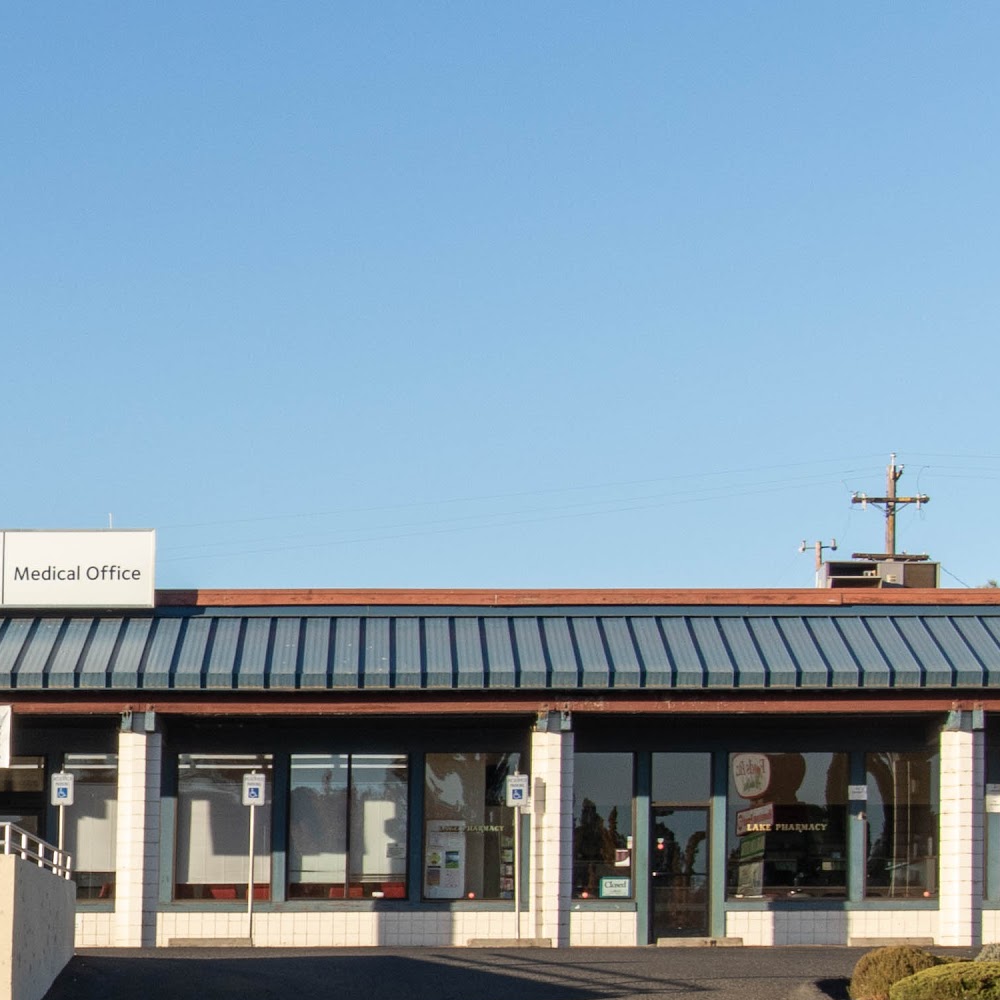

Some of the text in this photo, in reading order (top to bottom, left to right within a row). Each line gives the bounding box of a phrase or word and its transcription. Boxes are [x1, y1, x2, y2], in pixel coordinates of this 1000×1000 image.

[14, 565, 141, 581] Medical Office
[746, 823, 828, 833] LAKE PHARMACY
